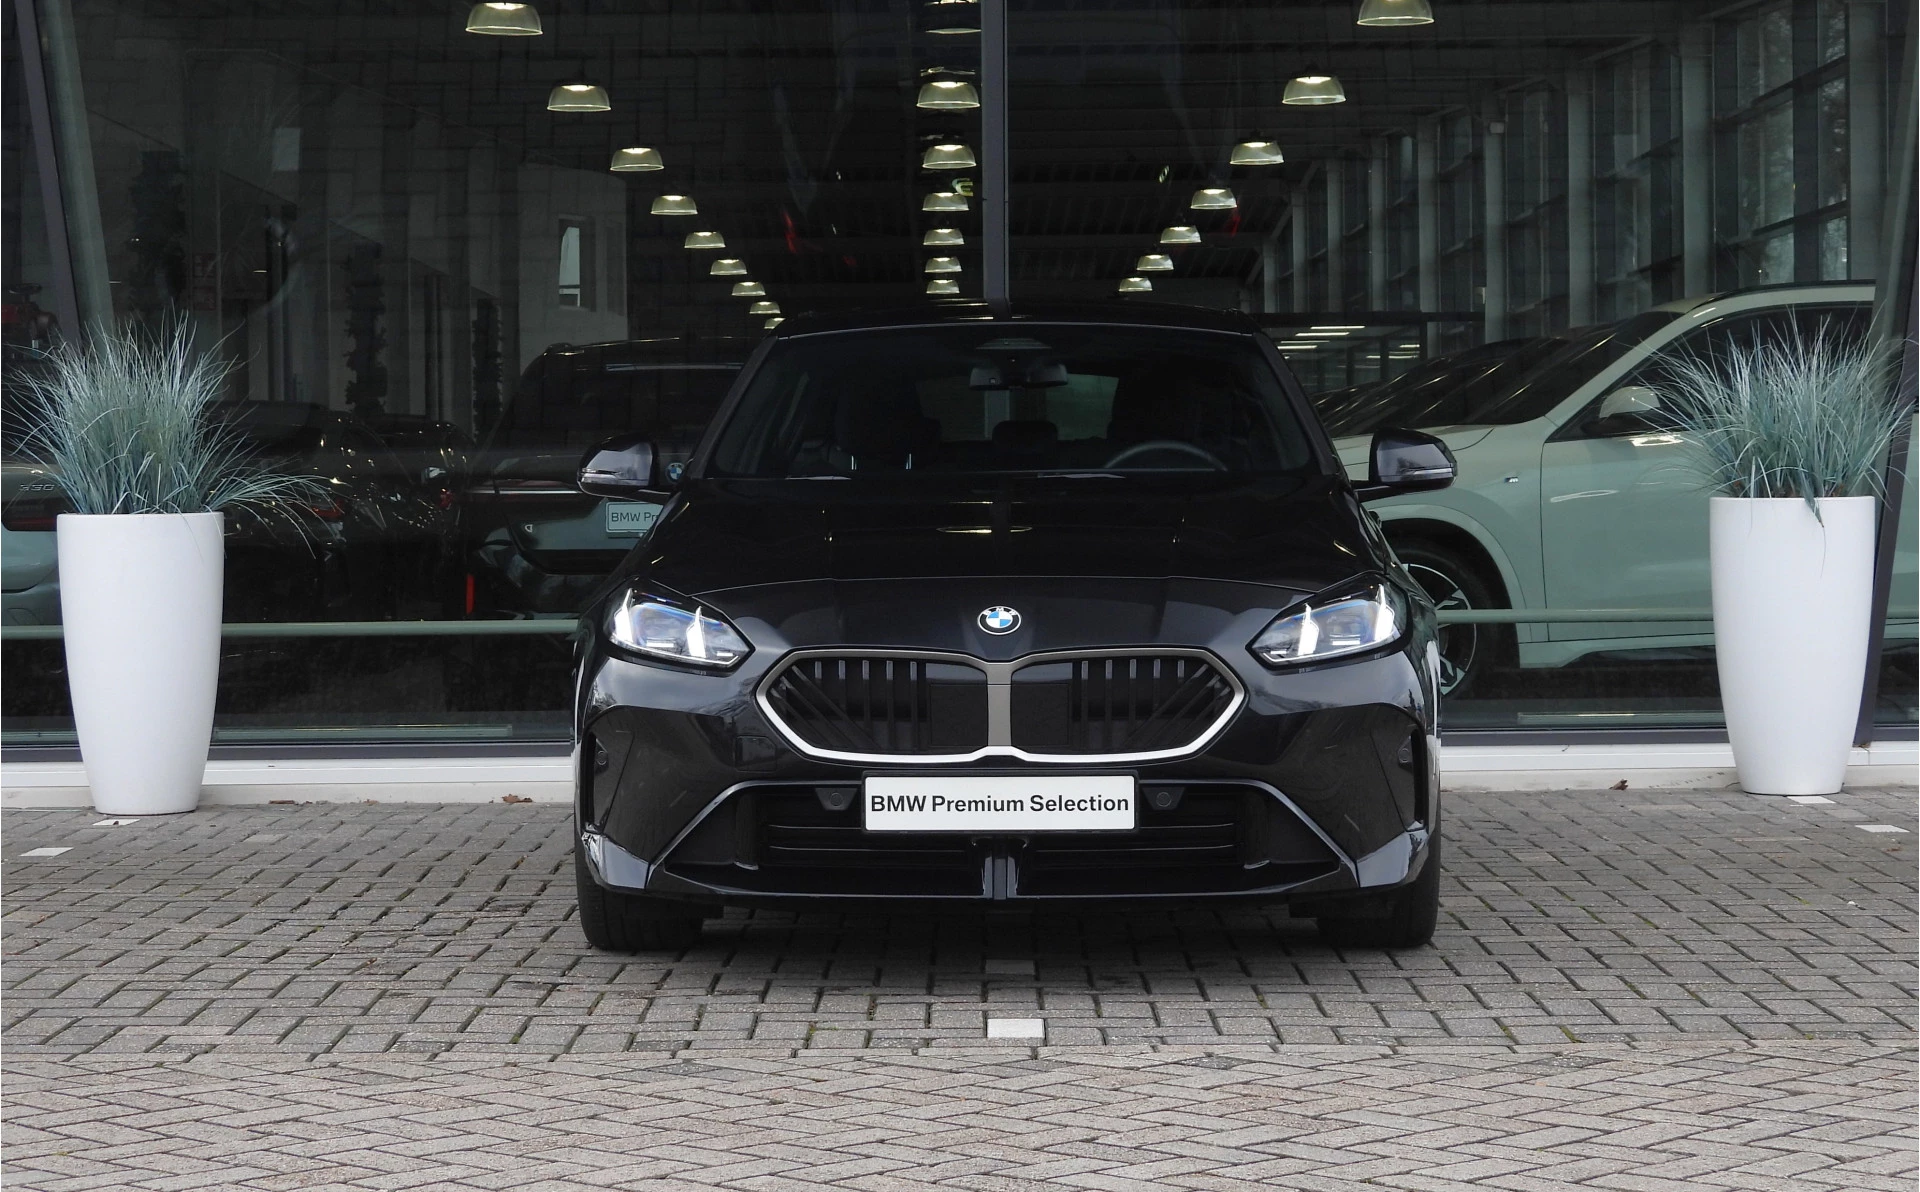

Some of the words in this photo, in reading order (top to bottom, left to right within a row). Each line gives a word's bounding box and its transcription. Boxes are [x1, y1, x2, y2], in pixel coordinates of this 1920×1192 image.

[611, 512, 641, 522] BMW
[871, 795, 927, 812] BMW
[932, 795, 1024, 812] Premium
[1029, 794, 1129, 812] Selection
